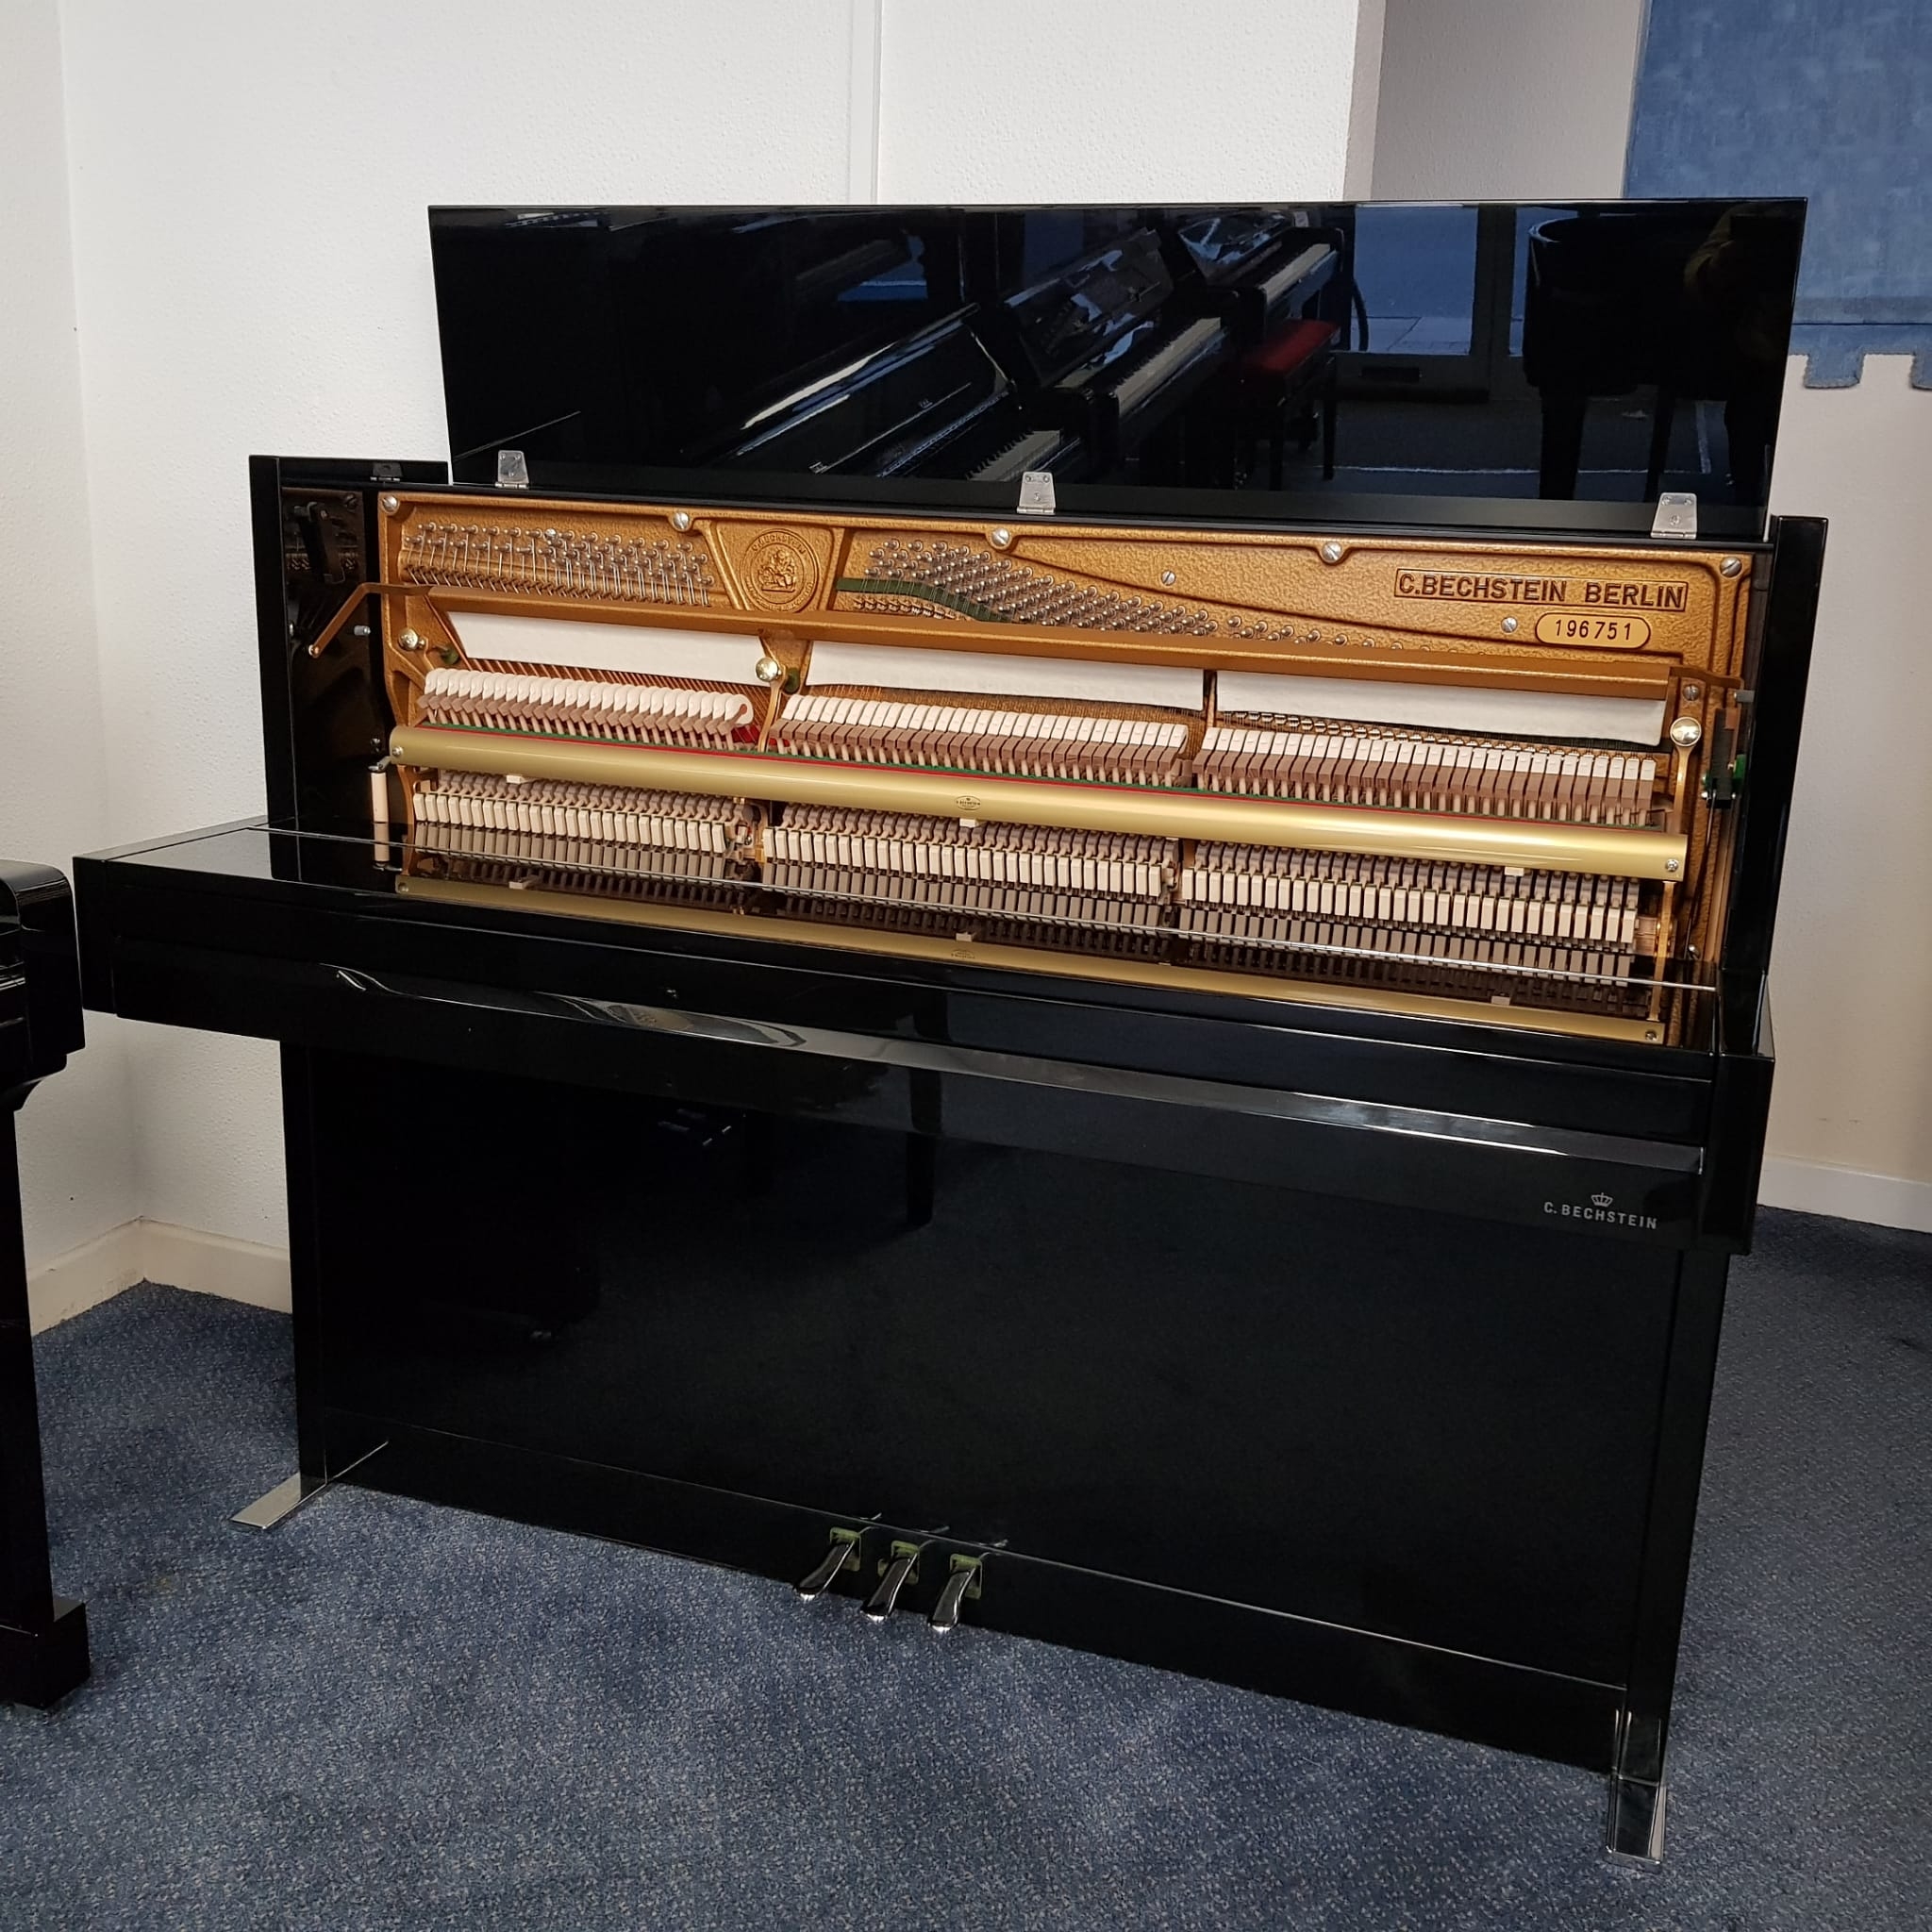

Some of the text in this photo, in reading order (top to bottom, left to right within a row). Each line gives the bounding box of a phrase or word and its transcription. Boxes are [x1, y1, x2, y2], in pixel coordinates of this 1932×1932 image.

[1399, 573, 1683, 608] C.BECHSTEIN BERLIN
[1556, 619, 1631, 641] 196751
[1561, 1204, 1657, 1229] BECHSTEIN
